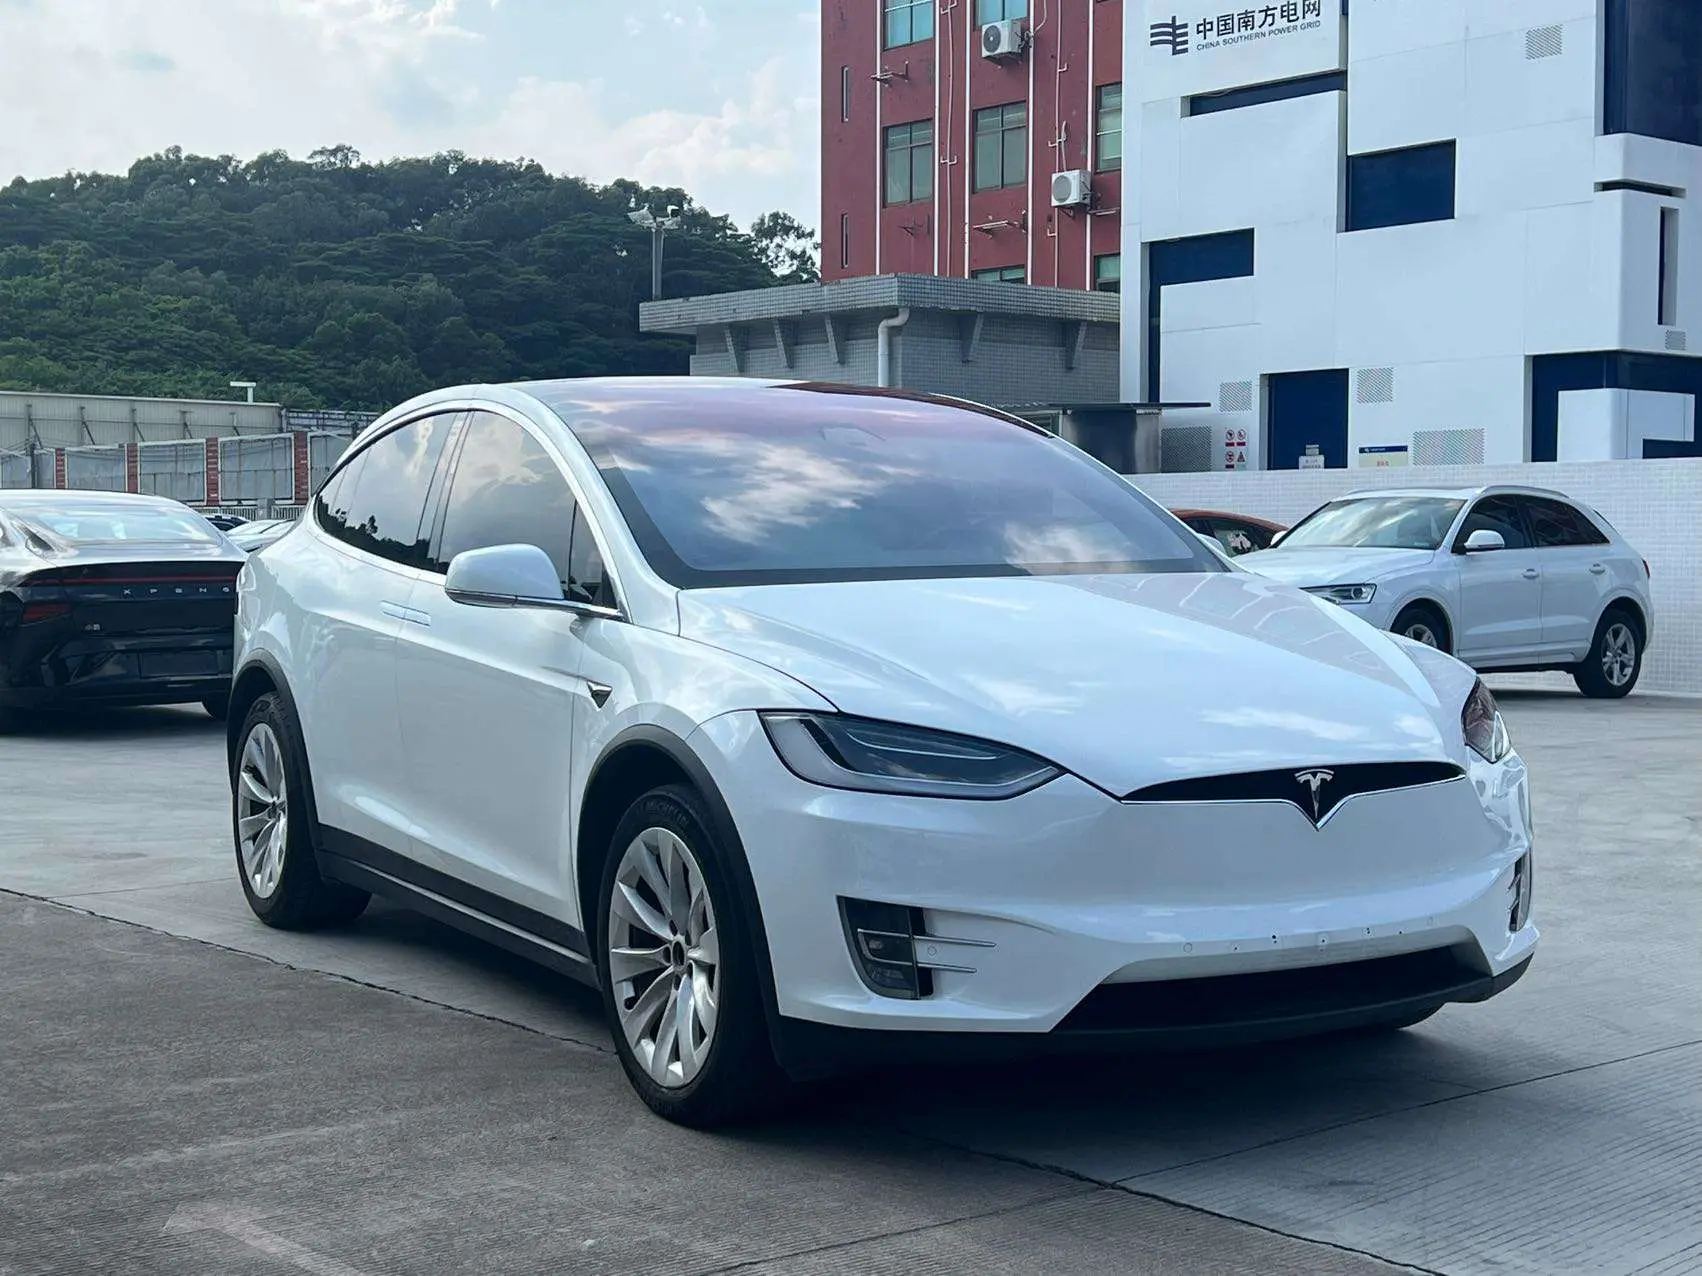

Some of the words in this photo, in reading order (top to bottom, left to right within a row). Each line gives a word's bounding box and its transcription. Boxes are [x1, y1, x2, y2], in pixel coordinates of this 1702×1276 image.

[1196, 0, 1321, 40] 中国南方电网
[1196, 40, 1221, 51] CHINA
[1222, 31, 1267, 46] SOUTHERN
[1268, 25, 1299, 36] POWER
[1300, 20, 1321, 31] GRID
